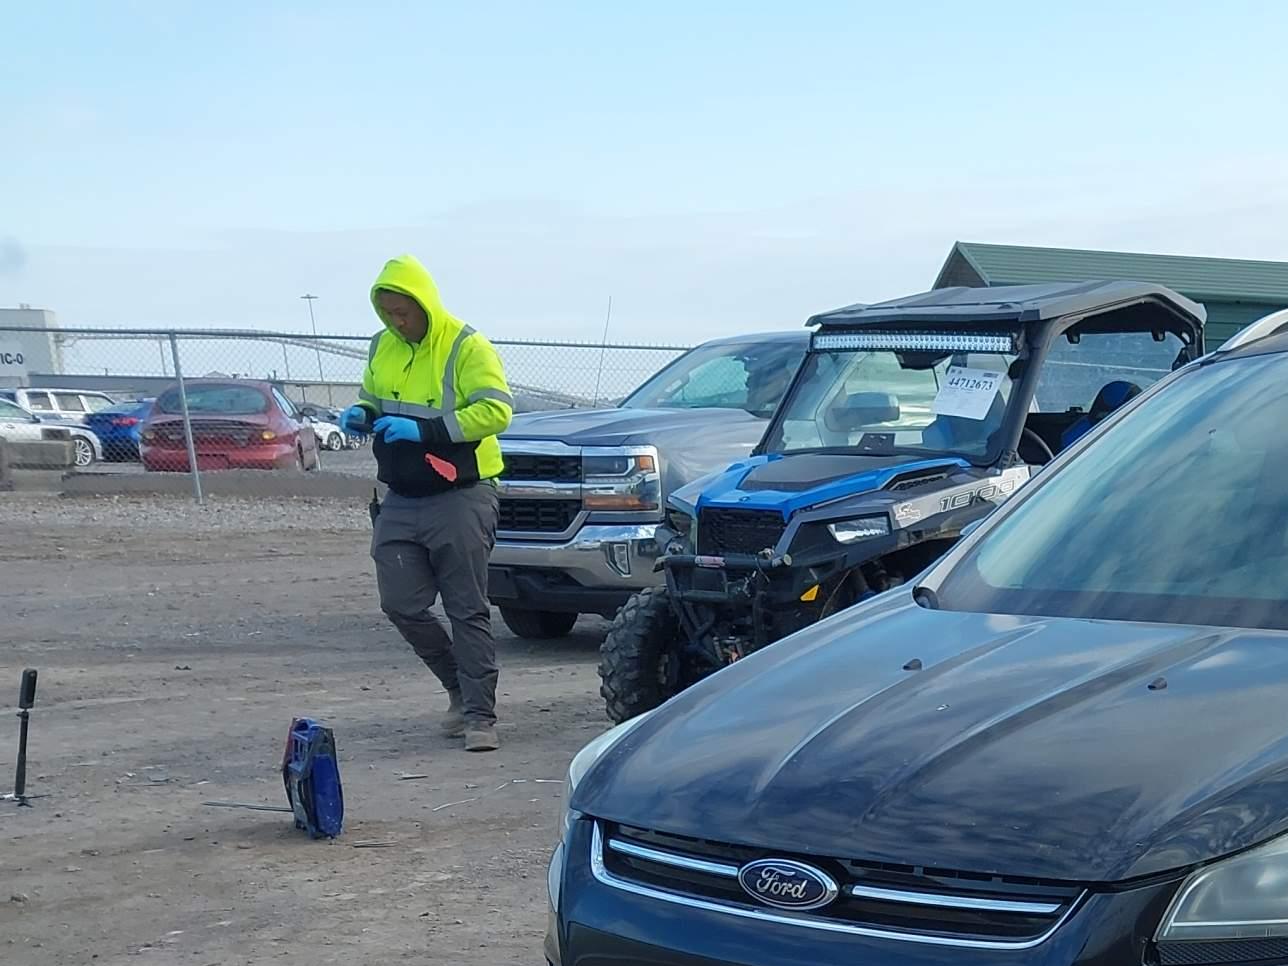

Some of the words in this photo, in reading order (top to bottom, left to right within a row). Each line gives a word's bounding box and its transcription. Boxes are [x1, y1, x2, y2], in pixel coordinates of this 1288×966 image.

[948, 377, 993, 391] 44712673
[939, 479, 1015, 512] 1000
[756, 866, 808, 899] Ford
